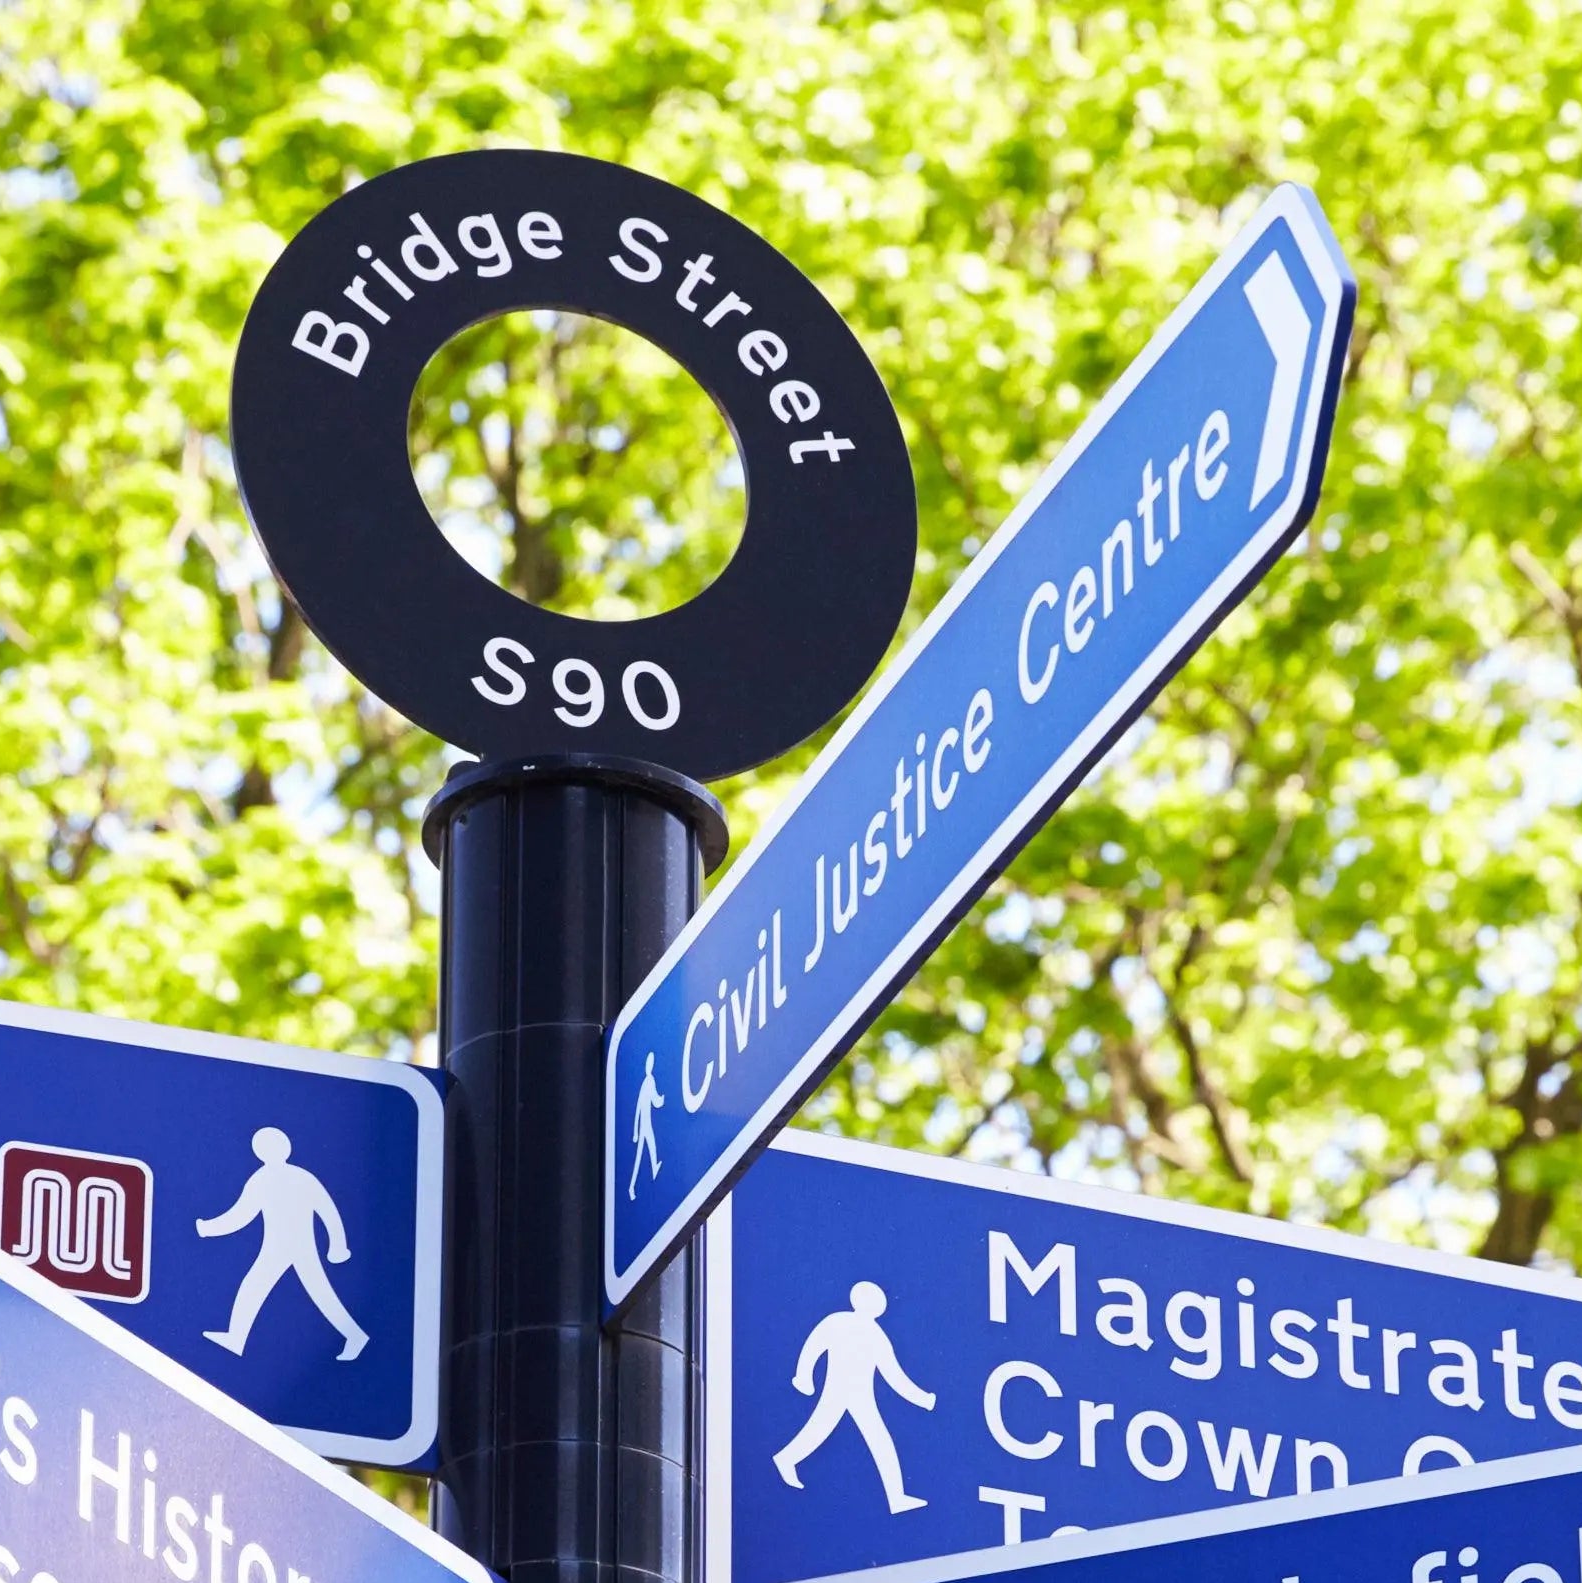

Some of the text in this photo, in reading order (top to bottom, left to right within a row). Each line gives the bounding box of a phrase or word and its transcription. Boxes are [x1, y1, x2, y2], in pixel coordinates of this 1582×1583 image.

[292, 210, 856, 465] Bridge Street
[470, 636, 681, 731] S90
[682, 409, 1231, 1114] Civil Justice Centre
[983, 1360, 1350, 1498] Crown
